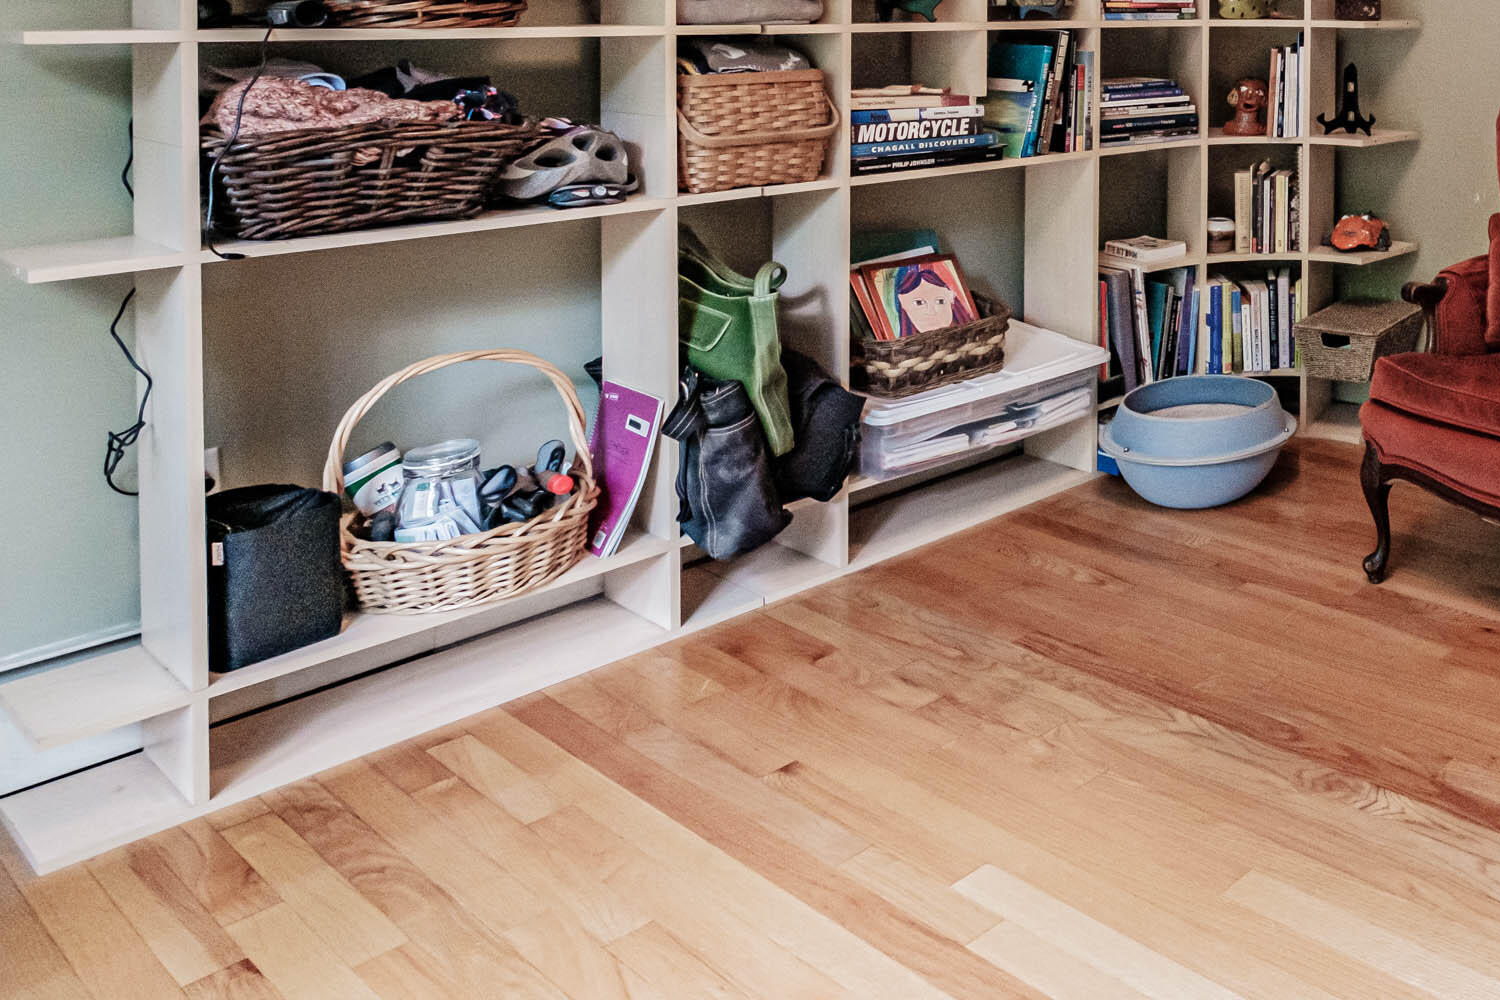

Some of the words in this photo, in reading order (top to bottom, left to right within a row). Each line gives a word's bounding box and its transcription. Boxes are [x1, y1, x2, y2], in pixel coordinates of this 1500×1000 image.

[857, 118, 970, 144] MOTORCYCLE
[871, 143, 916, 153] CHAGALL
[918, 138, 976, 149] DISCOVERED
[891, 160, 909, 169] PHILIP
[909, 158, 936, 167] JOHNSON
